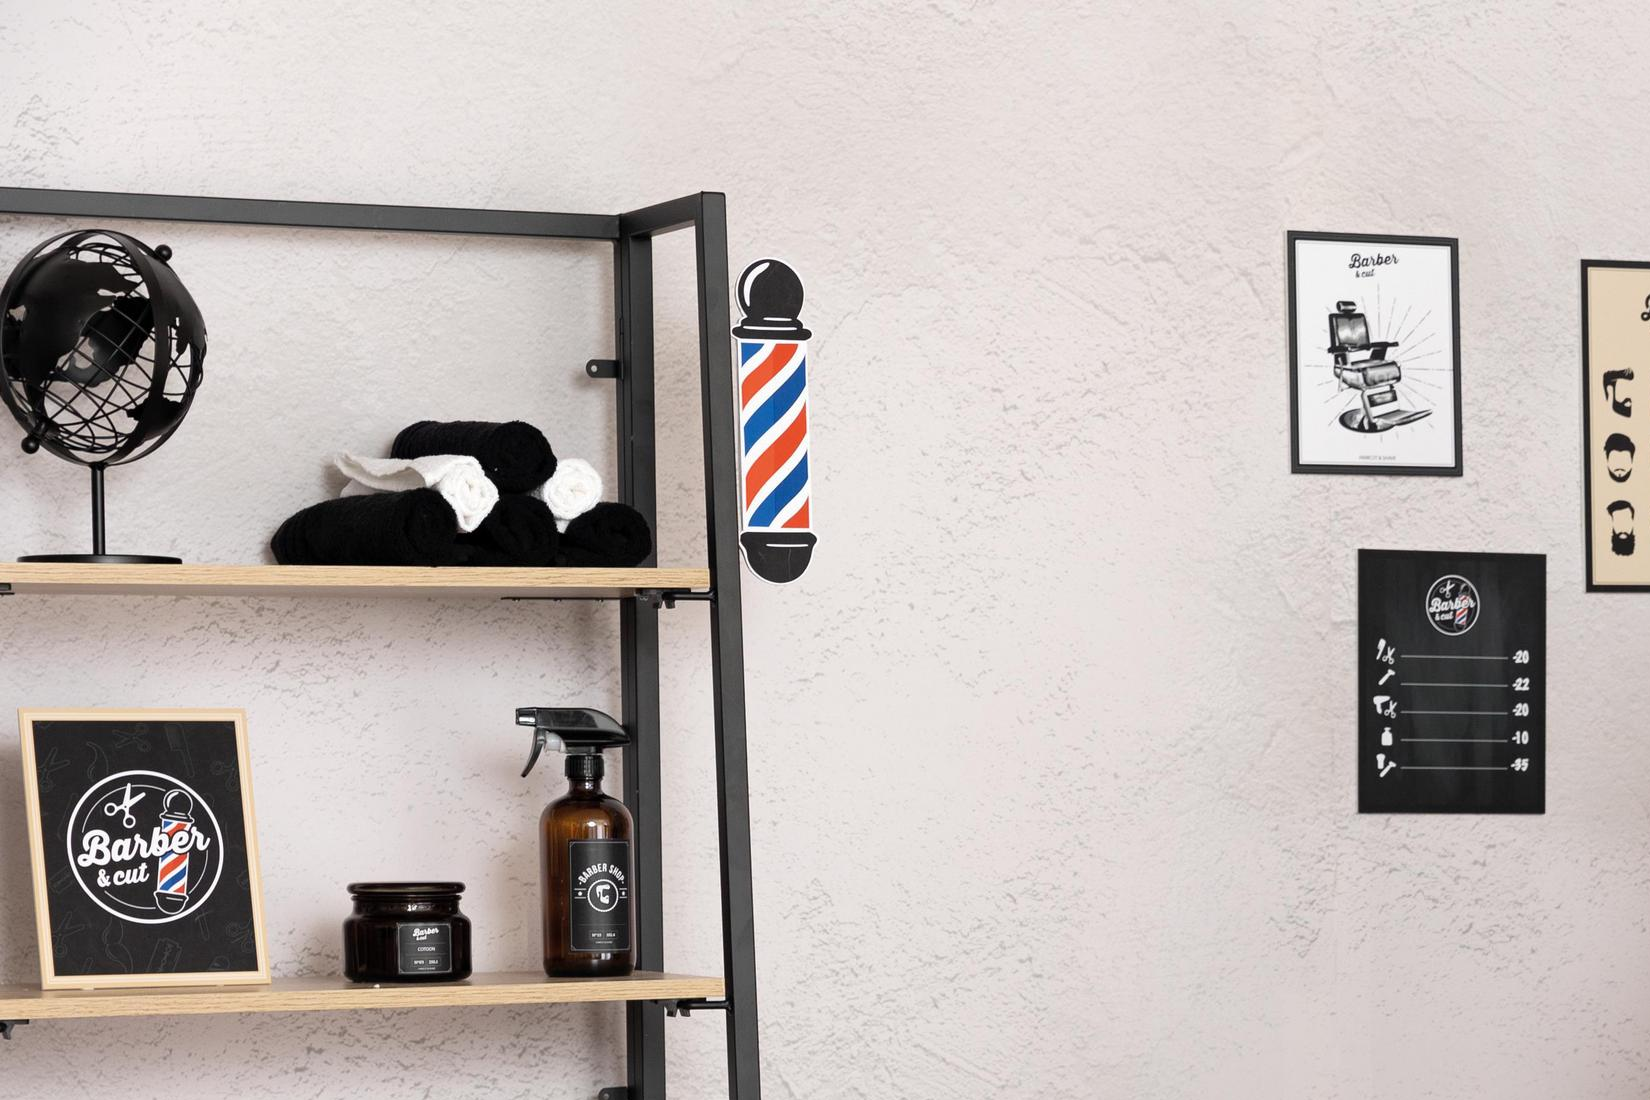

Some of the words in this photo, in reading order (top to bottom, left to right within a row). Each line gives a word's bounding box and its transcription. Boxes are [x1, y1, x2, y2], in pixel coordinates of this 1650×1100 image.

[1349, 253, 1399, 269] Barber
[1429, 597, 1476, 613] Barber
[78, 826, 211, 868] Barber
[96, 869, 112, 888] &
[113, 864, 150, 887] cut
[578, 863, 608, 885] BARBER
[608, 864, 625, 883] SHOP
[412, 927, 439, 937] Barber
